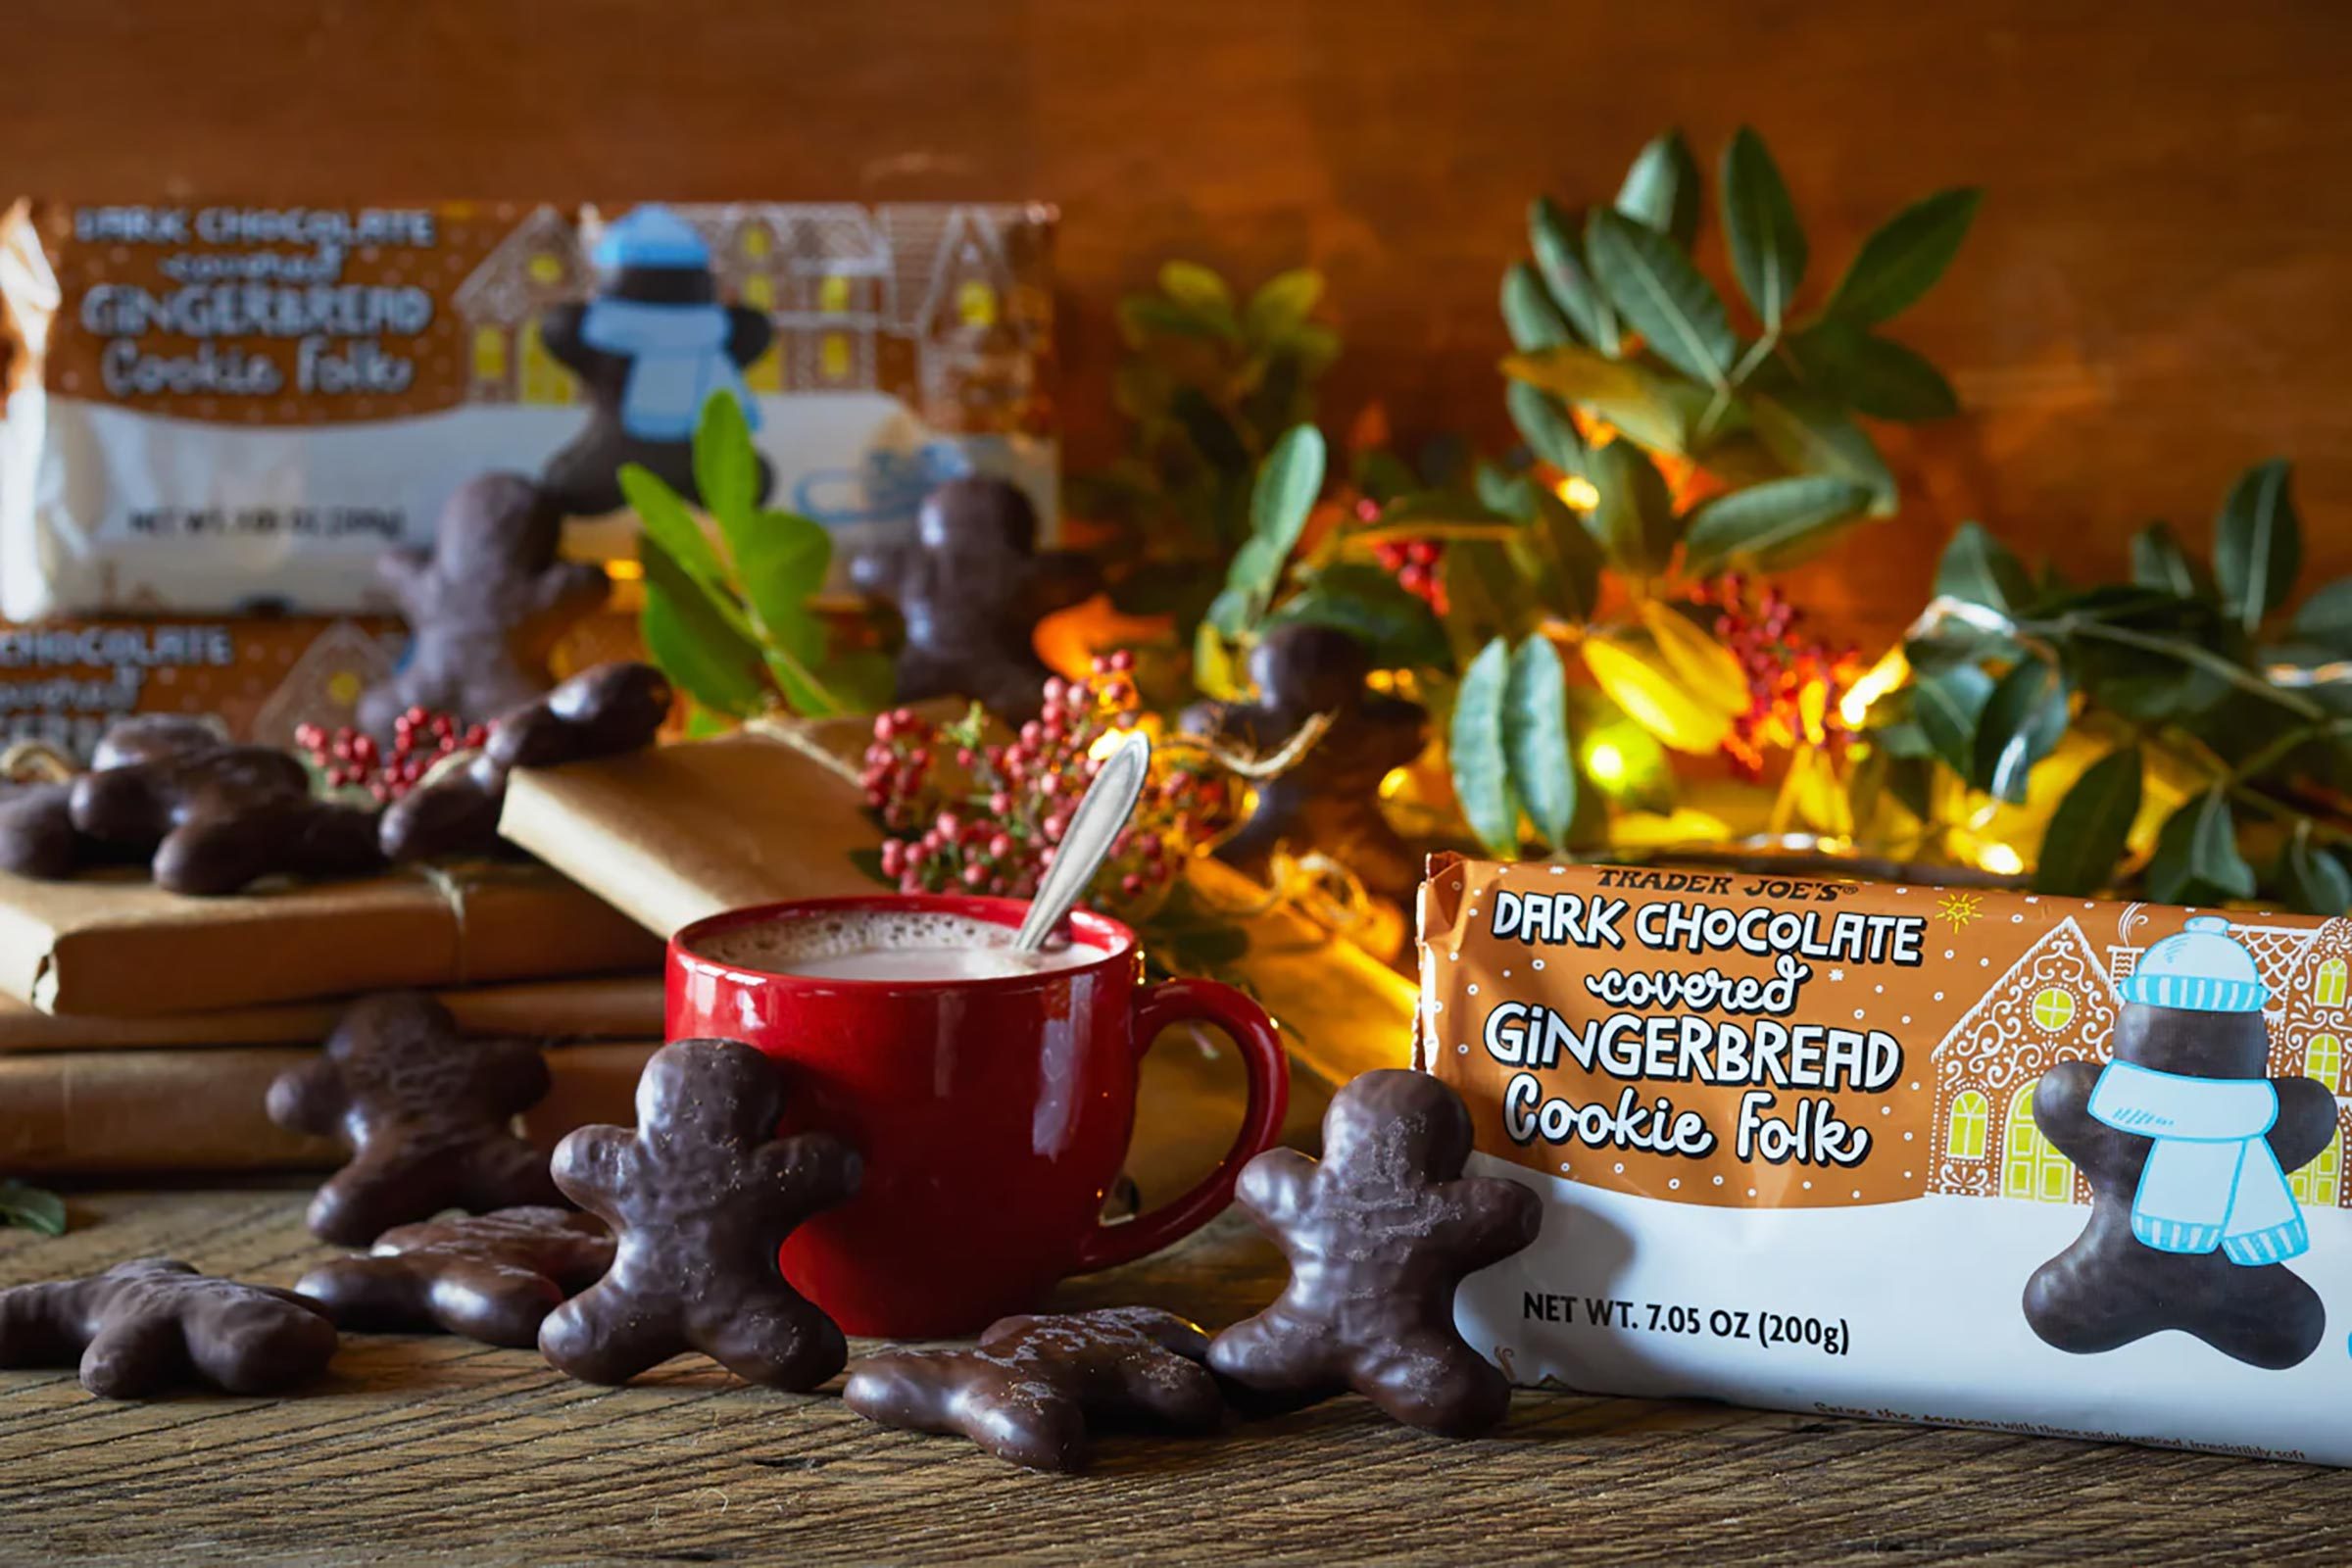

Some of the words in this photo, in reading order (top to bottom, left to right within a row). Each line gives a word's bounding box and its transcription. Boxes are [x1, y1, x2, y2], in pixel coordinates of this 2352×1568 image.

[1597, 868, 1733, 895] TRADER
[1492, 891, 1627, 949] DARK
[1634, 902, 1927, 965] CHOCOLATE
[1586, 952, 1811, 1016] covered
[1502, 1073, 1718, 1154] Cookie
[1736, 1090, 1873, 1165] Folk
[1523, 1292, 1577, 1323] NET
[1586, 1298, 1639, 1330] WT.
[1645, 1304, 1701, 1335] 7.05
[1709, 1308, 1750, 1340] OZ
[1759, 1312, 1850, 1356] (200g)
